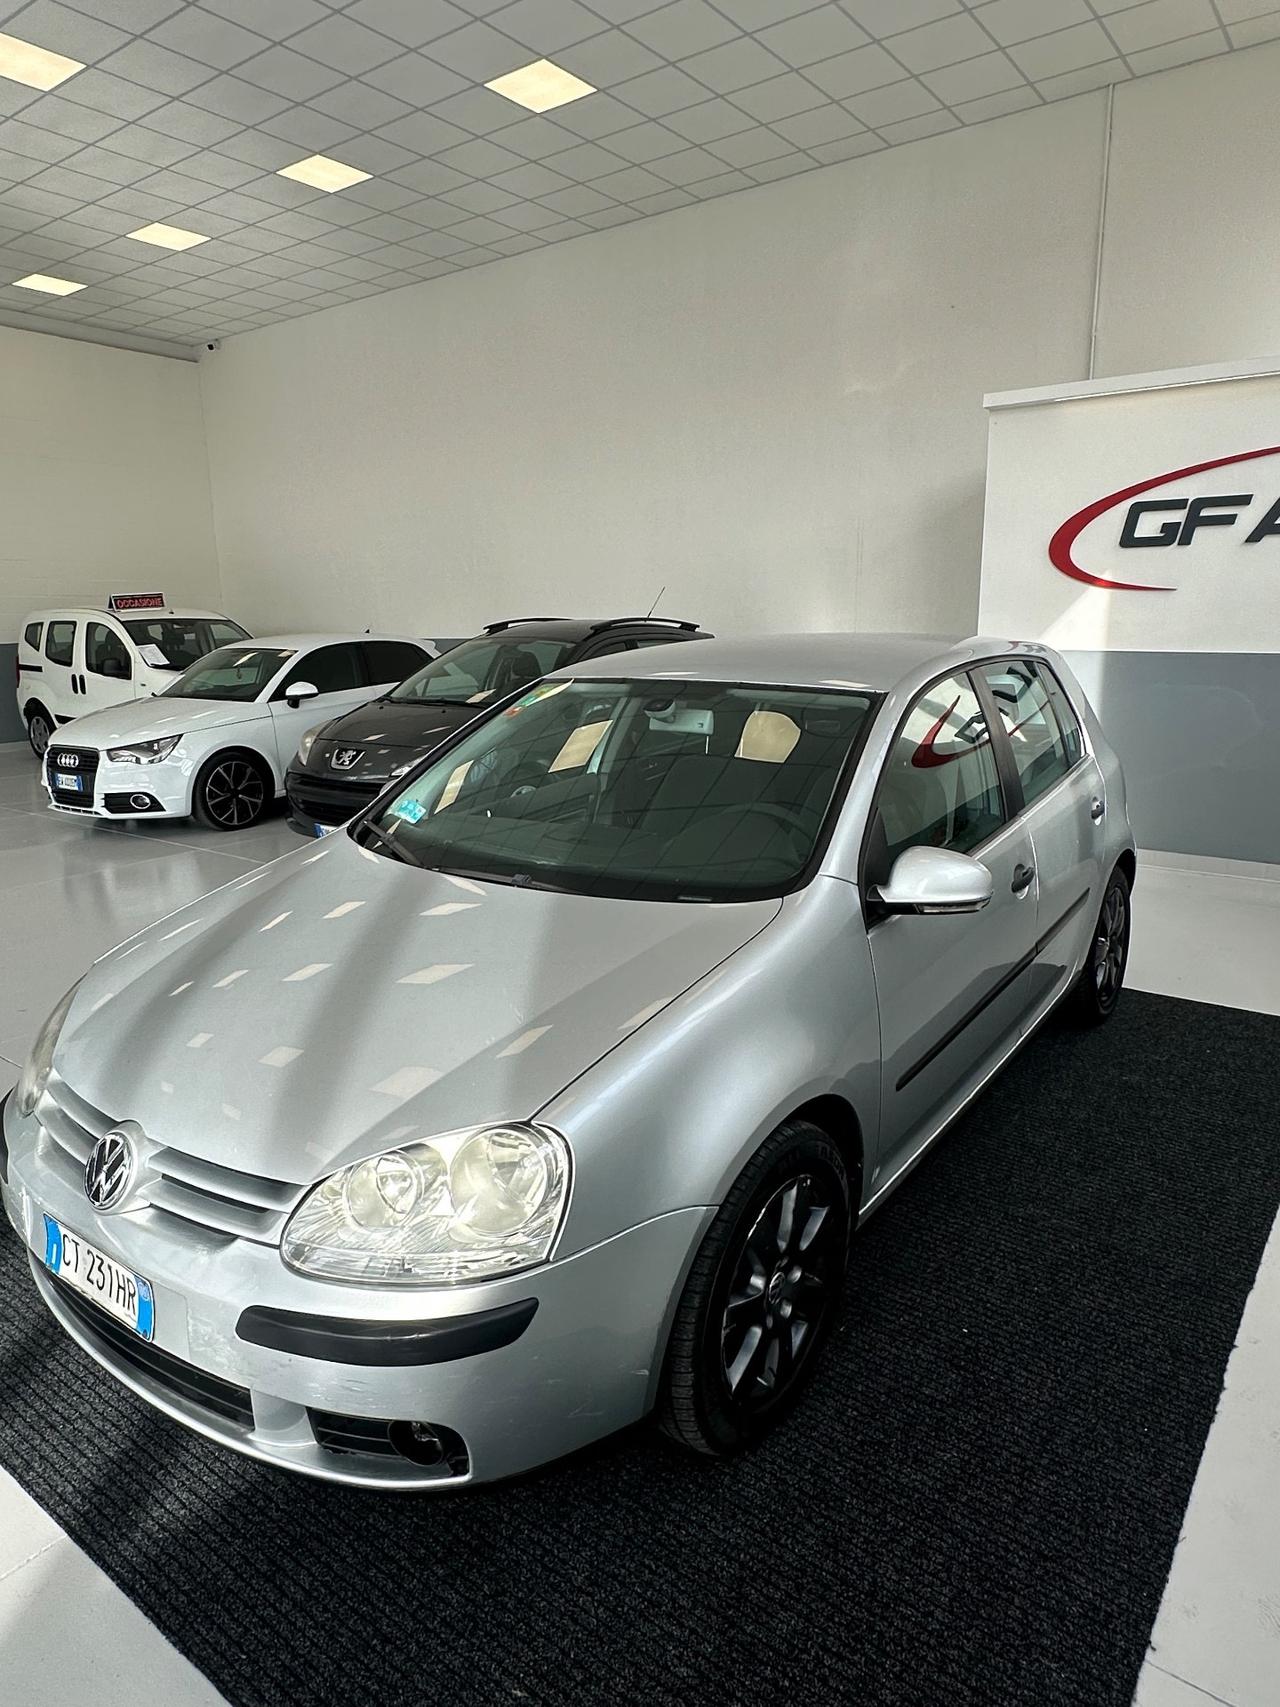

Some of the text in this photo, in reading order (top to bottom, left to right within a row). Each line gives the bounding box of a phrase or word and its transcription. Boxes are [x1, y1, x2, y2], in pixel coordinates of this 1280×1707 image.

[1119, 494, 1254, 548] GF
[117, 598, 162, 608] OCCASIONE
[62, 1233, 137, 1315] CT 231HR
